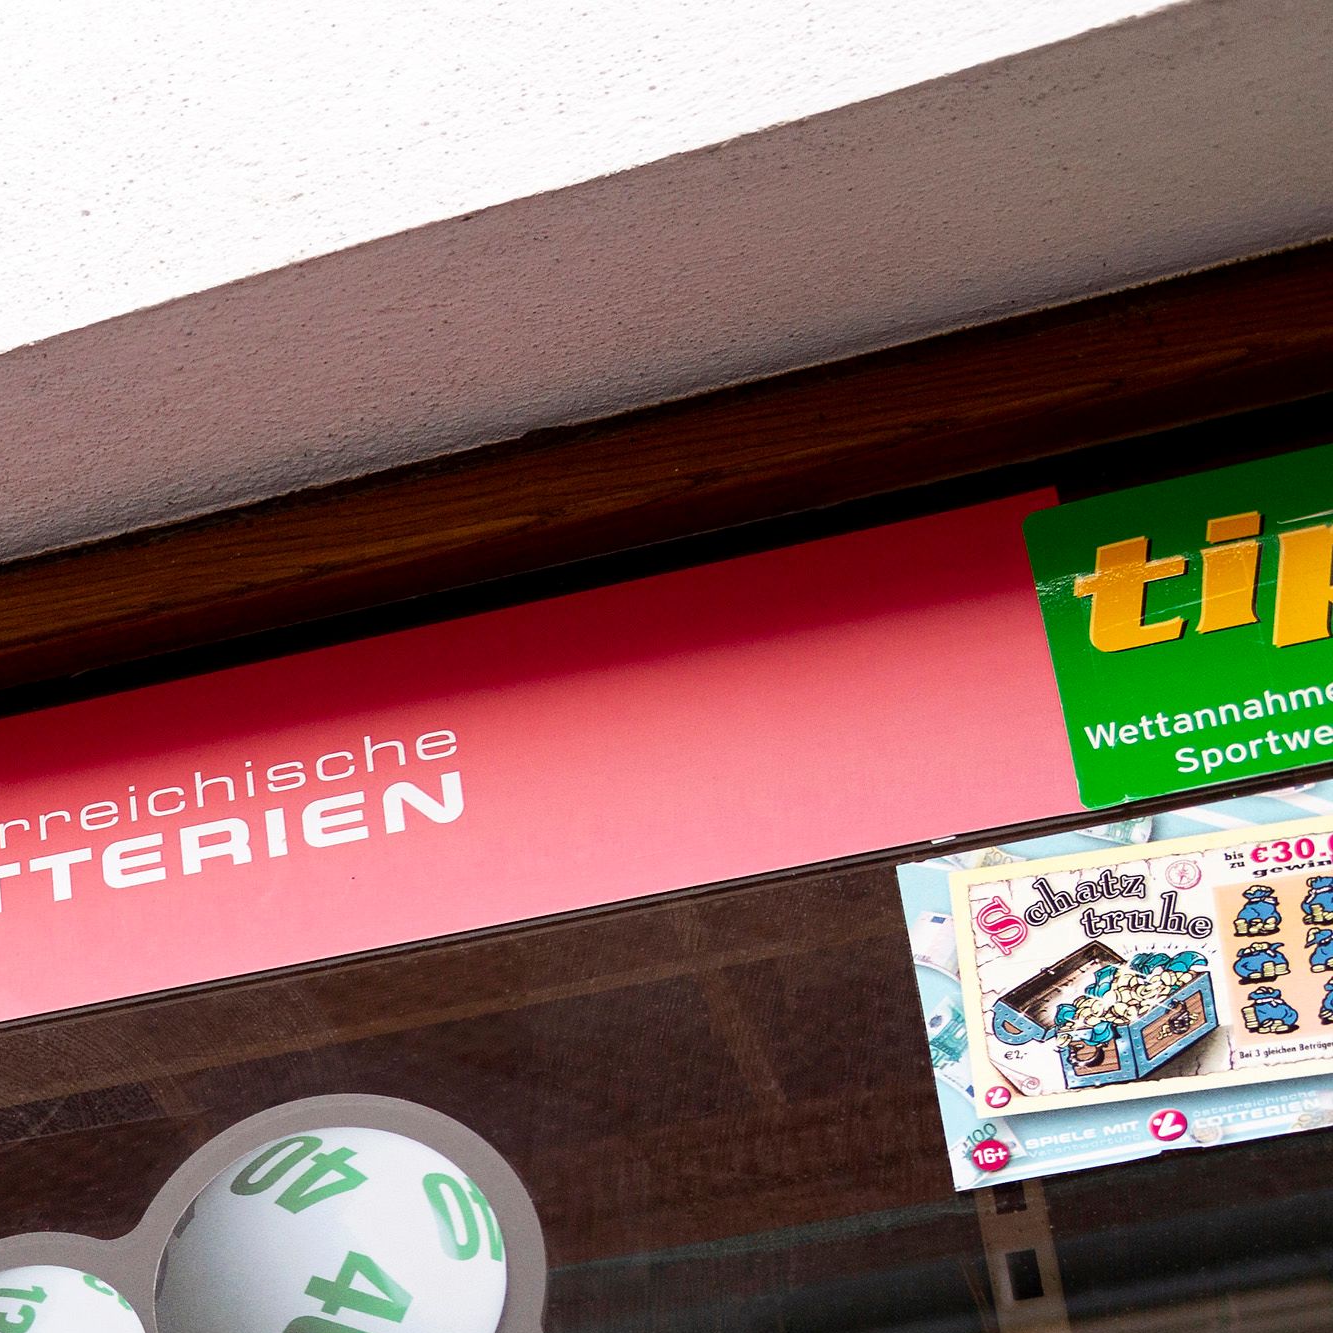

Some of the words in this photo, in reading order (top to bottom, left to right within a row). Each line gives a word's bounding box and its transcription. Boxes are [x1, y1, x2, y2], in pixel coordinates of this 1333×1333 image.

[1224, 851, 1244, 861] bis
[1250, 833, 1333, 863] €30.
[976, 869, 1146, 956] Schatz
[1081, 890, 1213, 938] truhe
[1239, 1051, 1252, 1059] Bei
[1255, 1049, 1261, 1057] 3
[1263, 1045, 1296, 1058] gleichen
[1299, 1041, 1333, 1050] Beträge
[1194, 1099, 1318, 1128] LOTTERIEN
[1025, 1129, 1096, 1149] SPIELE
[1103, 1121, 1139, 1136] MIT
[973, 1148, 1008, 1165] 16+
[230, 1136, 368, 1214] 40
